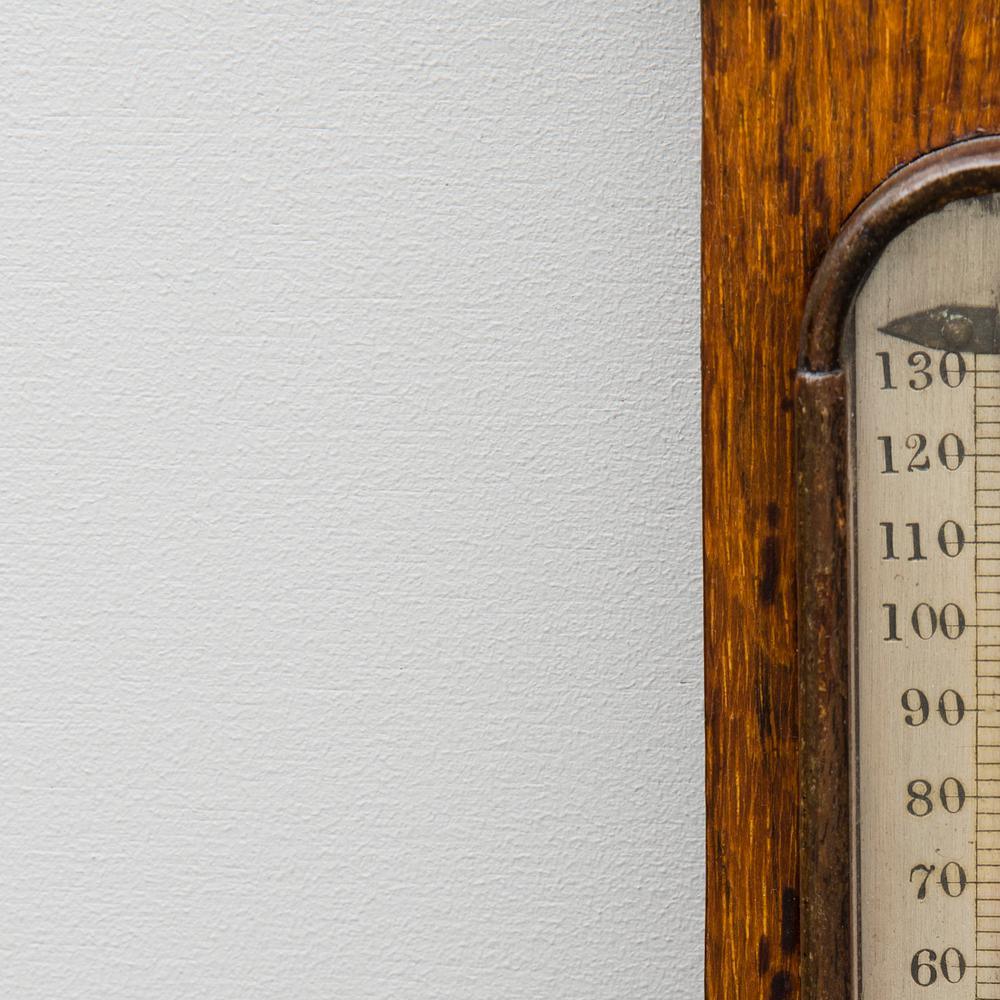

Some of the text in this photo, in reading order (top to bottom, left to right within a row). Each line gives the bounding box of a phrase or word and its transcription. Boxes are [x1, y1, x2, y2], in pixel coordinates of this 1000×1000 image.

[875, 351, 966, 391] 130
[878, 432, 965, 475] 120
[879, 519, 966, 562] 110
[882, 602, 966, 642] 100
[900, 687, 966, 728] 90
[905, 777, 966, 818] 80
[909, 860, 968, 900] 70
[910, 946, 967, 988] 60
